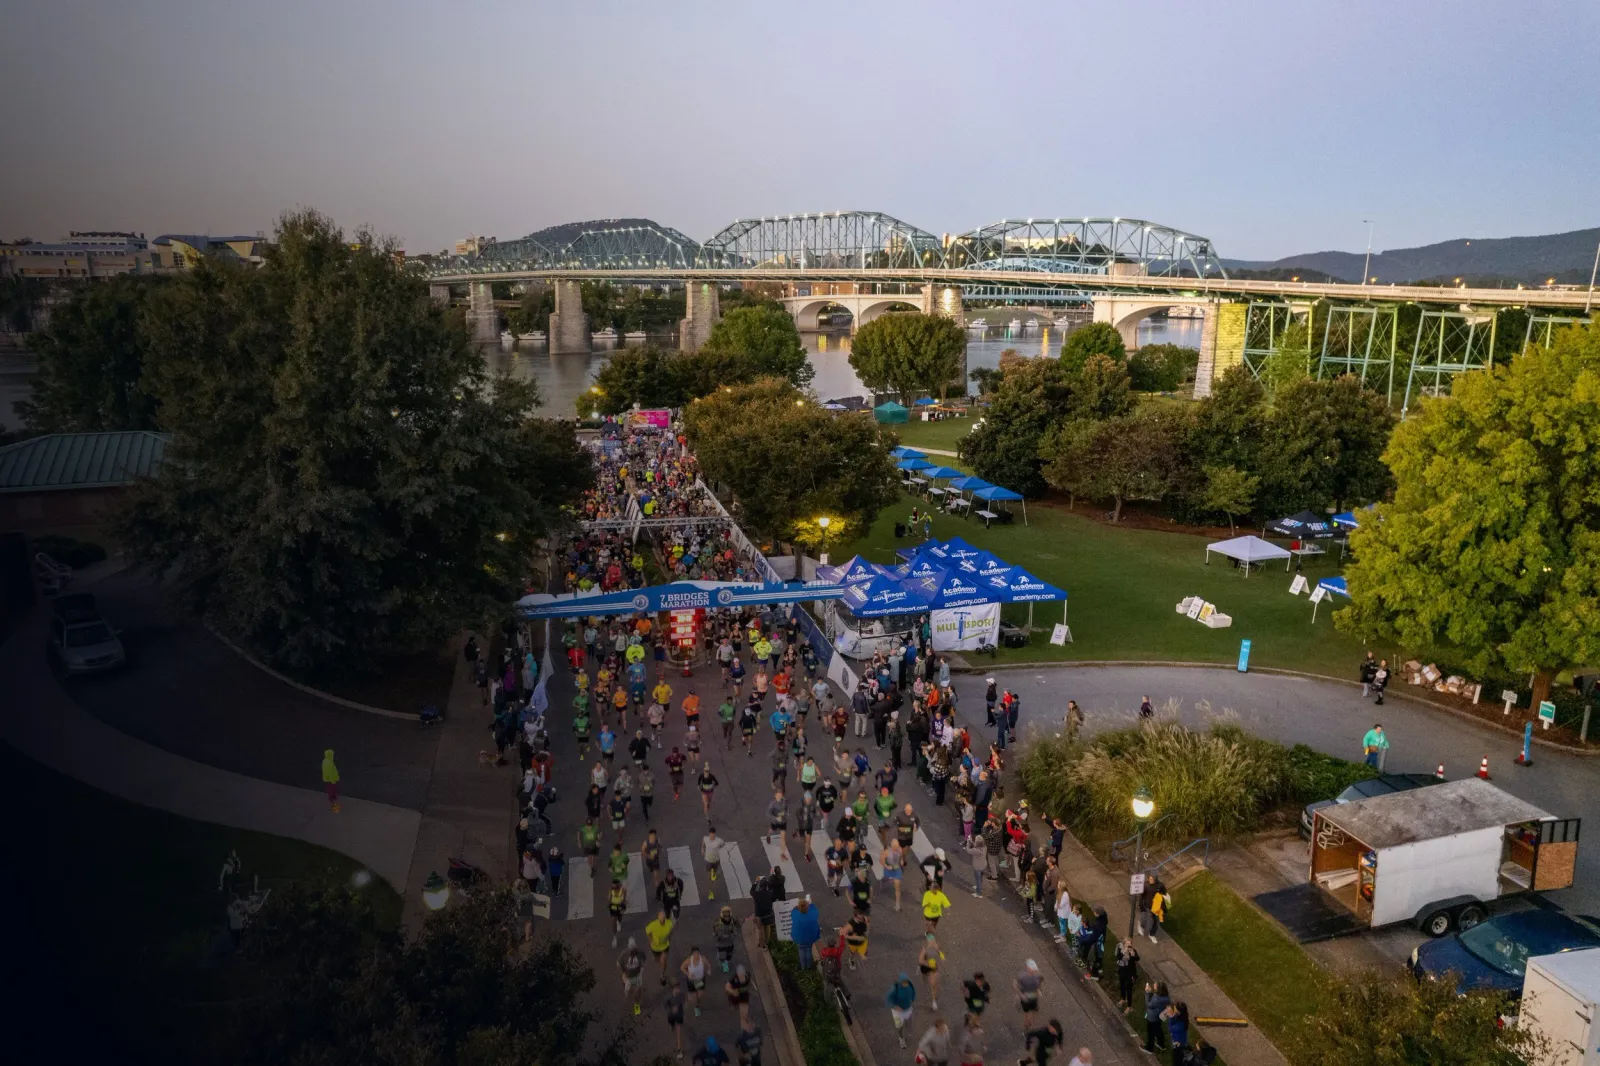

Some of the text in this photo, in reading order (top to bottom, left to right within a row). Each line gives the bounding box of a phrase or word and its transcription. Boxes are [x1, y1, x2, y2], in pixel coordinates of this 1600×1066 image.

[943, 587, 977, 595] Academy
[667, 592, 709, 601] BRIDGES
[660, 599, 709, 608] MARATHON
[944, 597, 987, 607] academy.com
